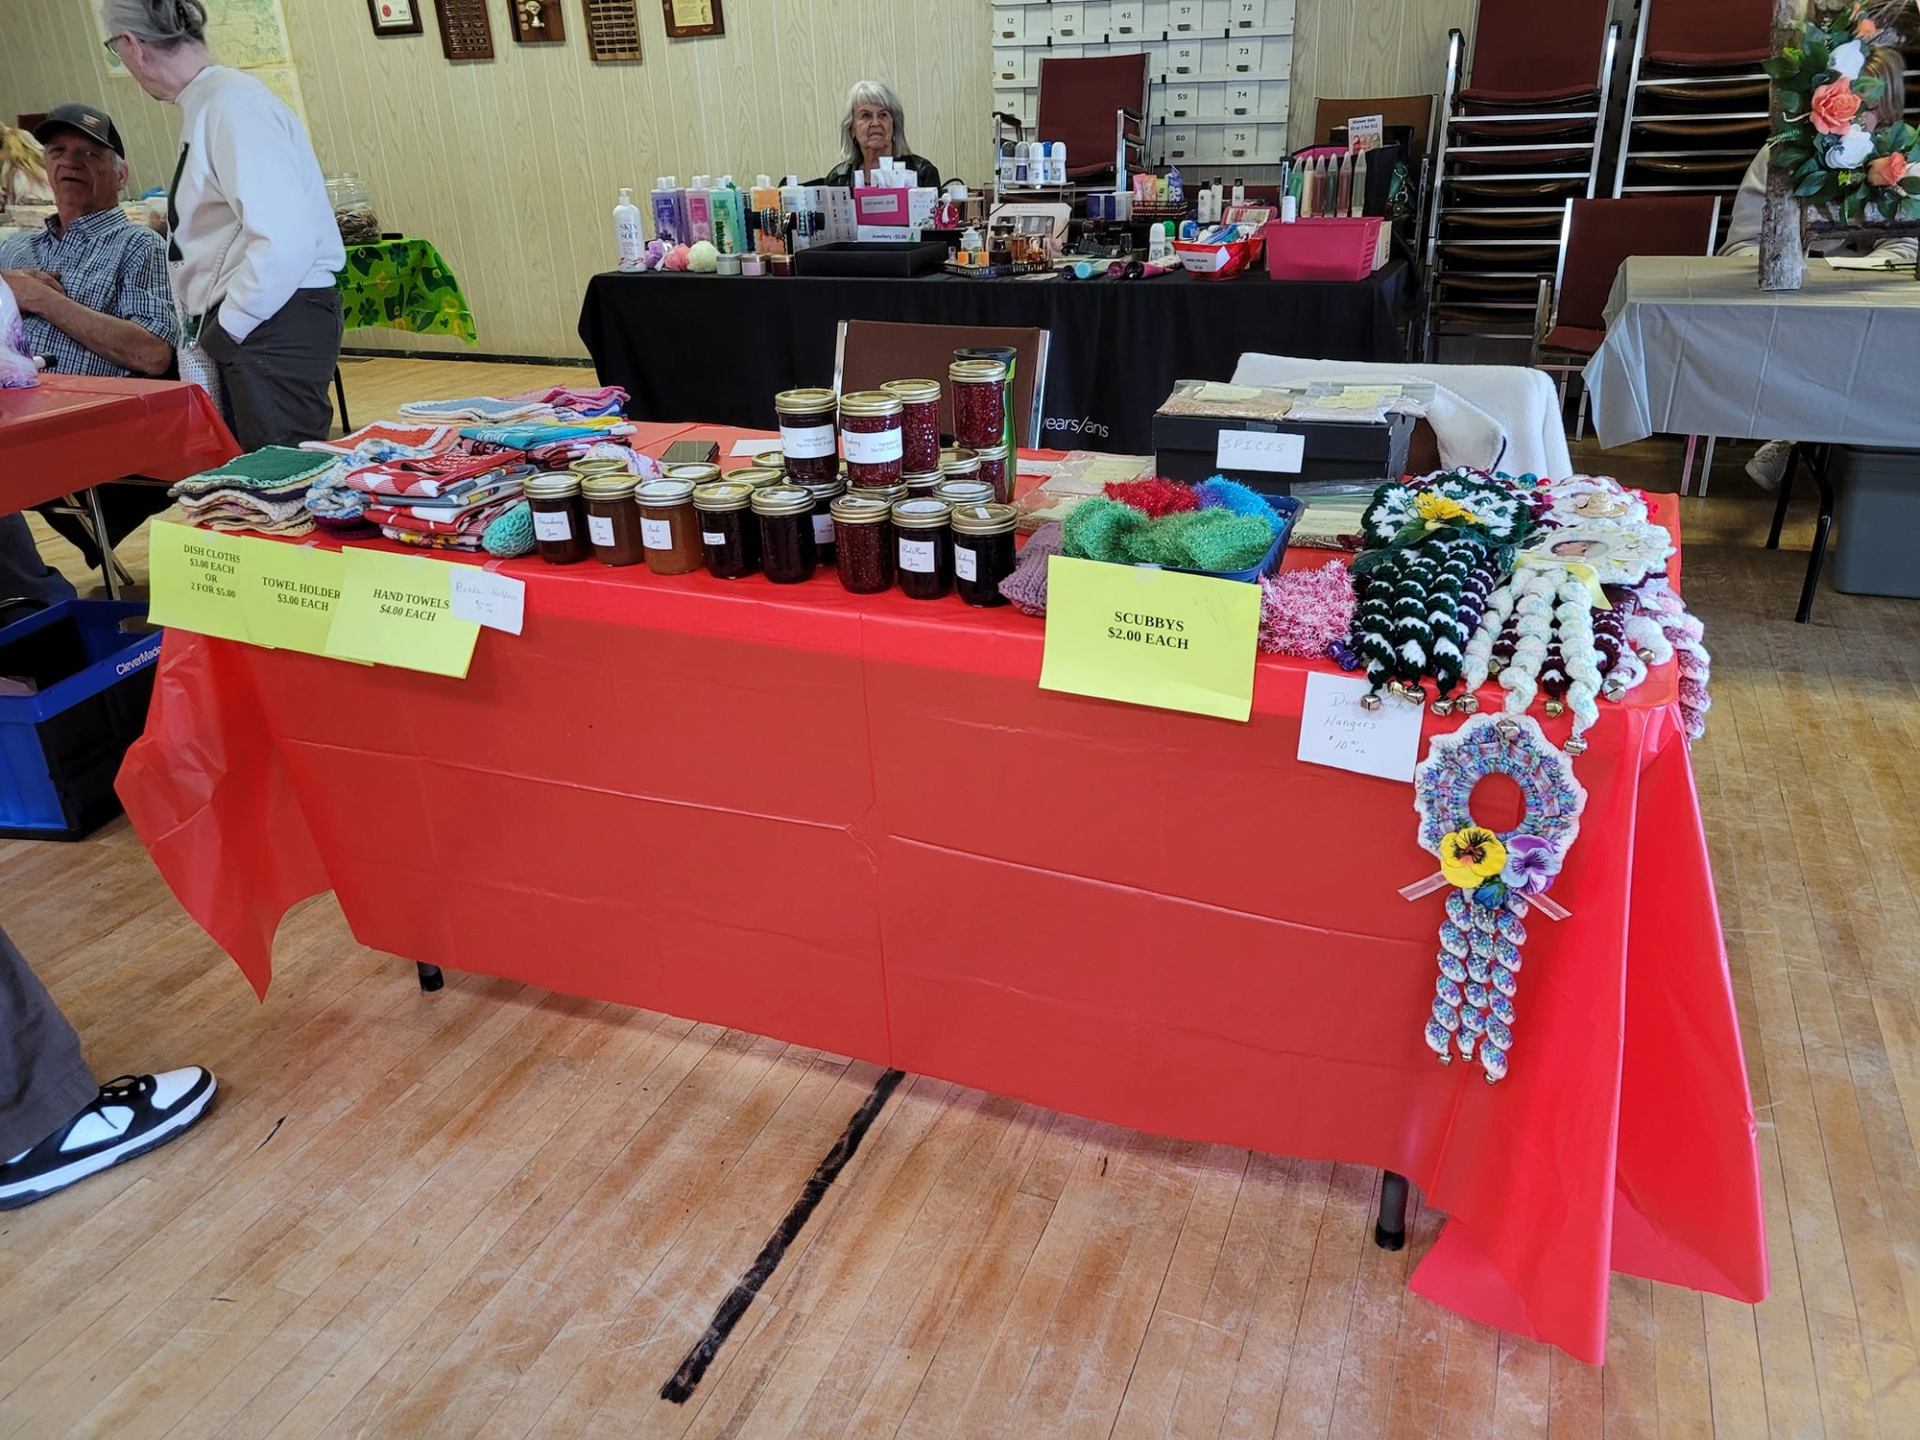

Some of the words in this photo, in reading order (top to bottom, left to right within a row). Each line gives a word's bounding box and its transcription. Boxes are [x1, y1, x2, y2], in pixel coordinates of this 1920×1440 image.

[620, 223, 638, 231] SKIN
[183, 544, 204, 557] DISH
[206, 549, 240, 564] CLOTHS
[189, 557, 209, 570] $3.00
[210, 561, 235, 575] EACH
[191, 581, 196, 591] 2
[197, 583, 215, 595] FOR
[204, 573, 218, 584] OR
[261, 576, 297, 593] TOWEL
[299, 583, 341, 600] HOLDER
[277, 592, 299, 606] $3.00
[300, 597, 329, 612] EACH
[373, 588, 404, 602] HAND
[405, 594, 450, 610] TOWELS
[379, 604, 404, 616] $4.00
[405, 606, 437, 622] EACH
[1114, 610, 1185, 633] SCUBBYS
[1107, 626, 1142, 642] $2.00
[1145, 632, 1189, 650] EACH
[1324, 714, 1377, 732] Hangers
